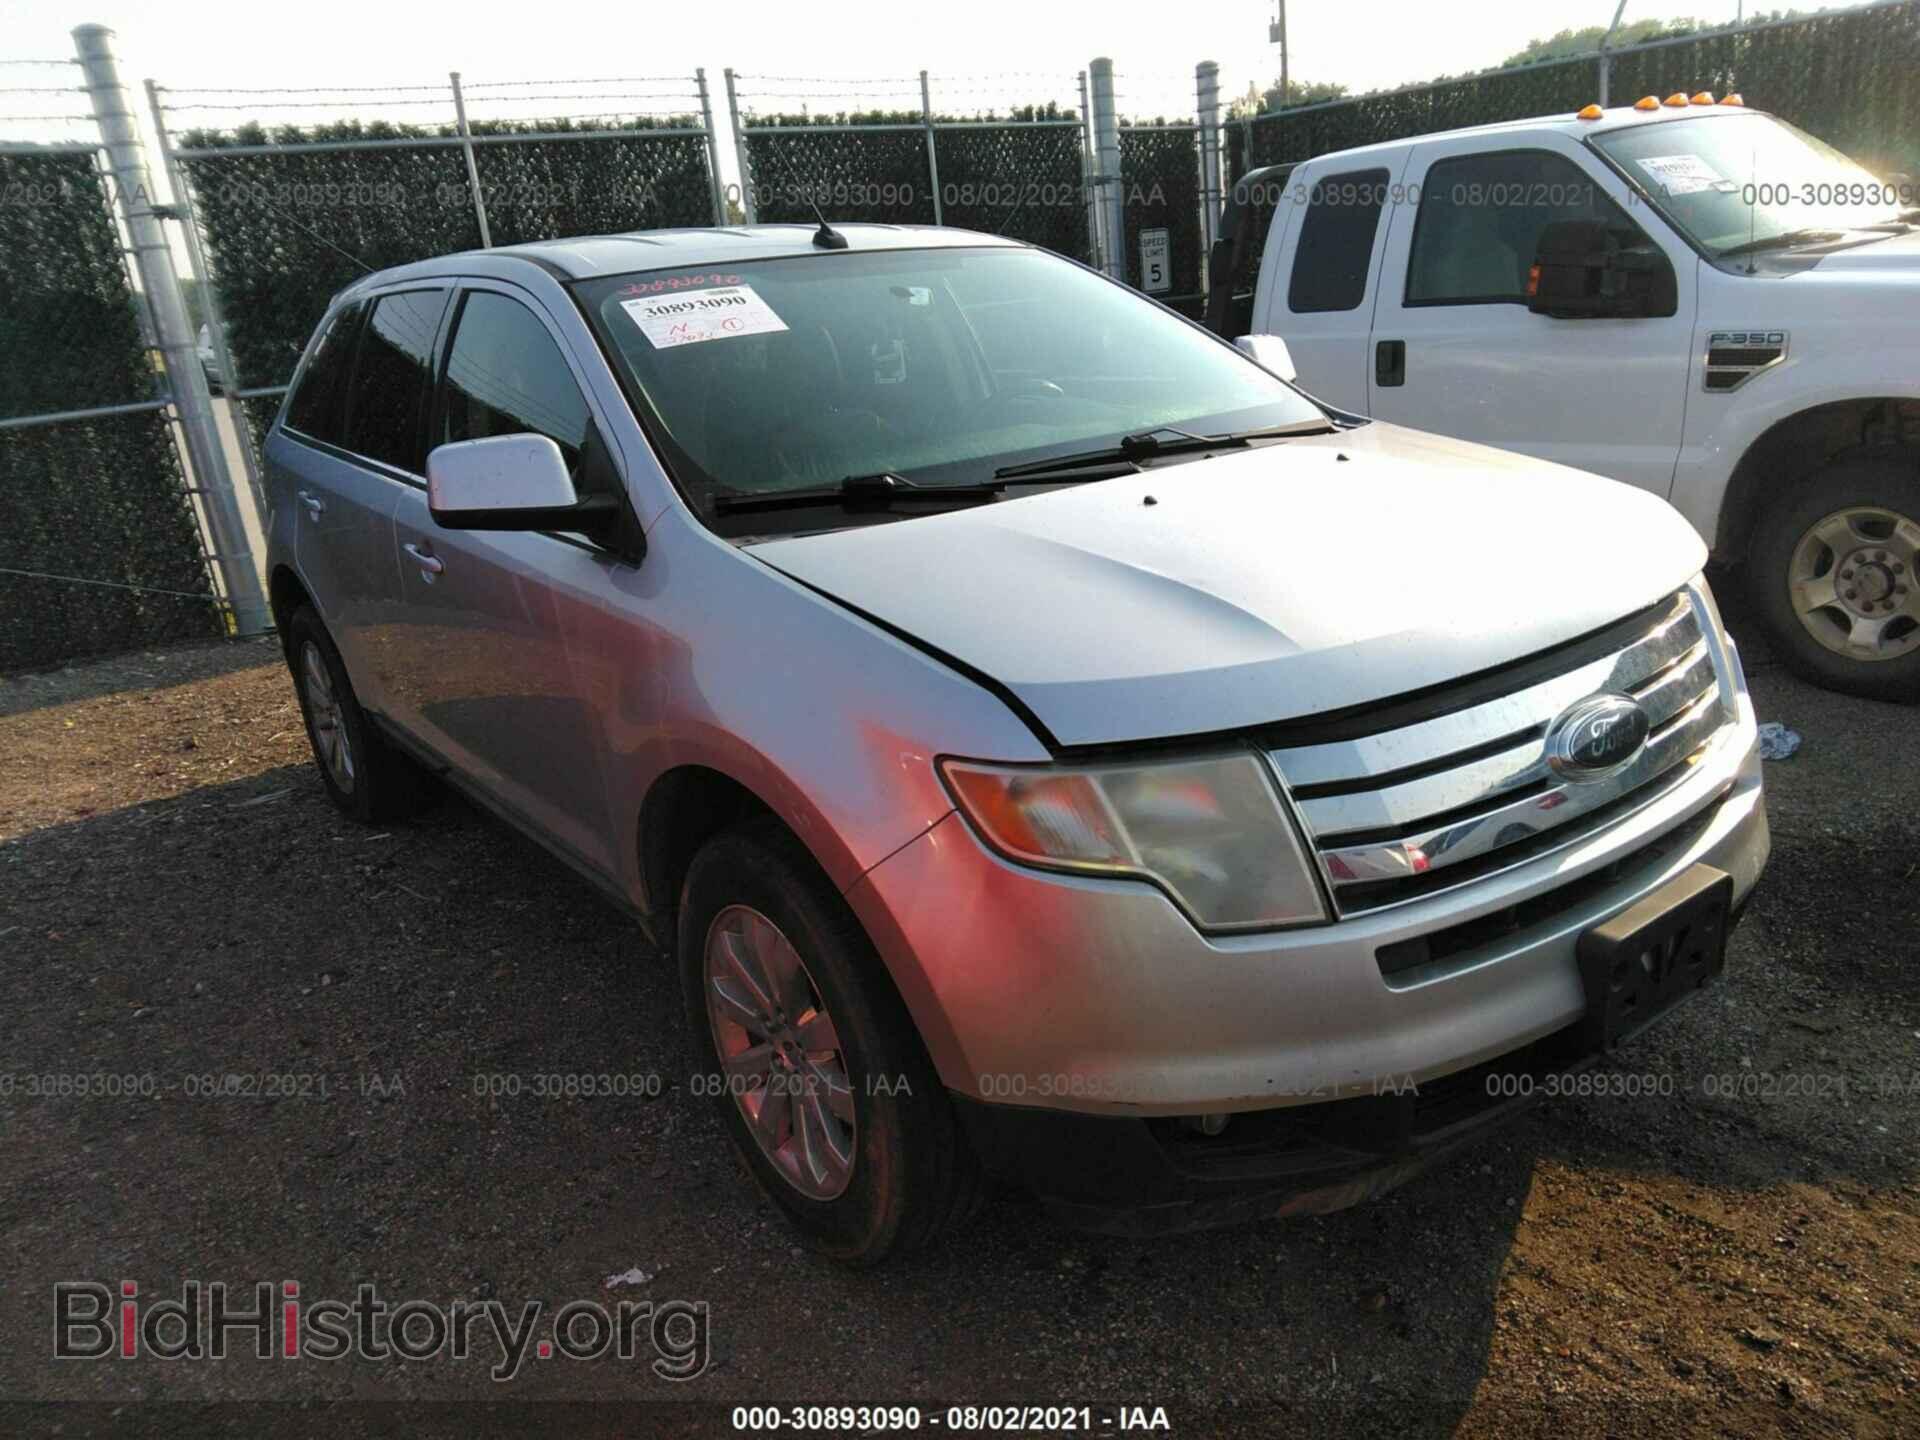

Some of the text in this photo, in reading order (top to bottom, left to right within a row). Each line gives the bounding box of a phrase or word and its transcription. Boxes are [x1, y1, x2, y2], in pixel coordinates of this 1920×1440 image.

[1151, 264, 1162, 282] 5
[644, 296, 747, 318] 30893090
[1710, 332, 1785, 345] F-350
